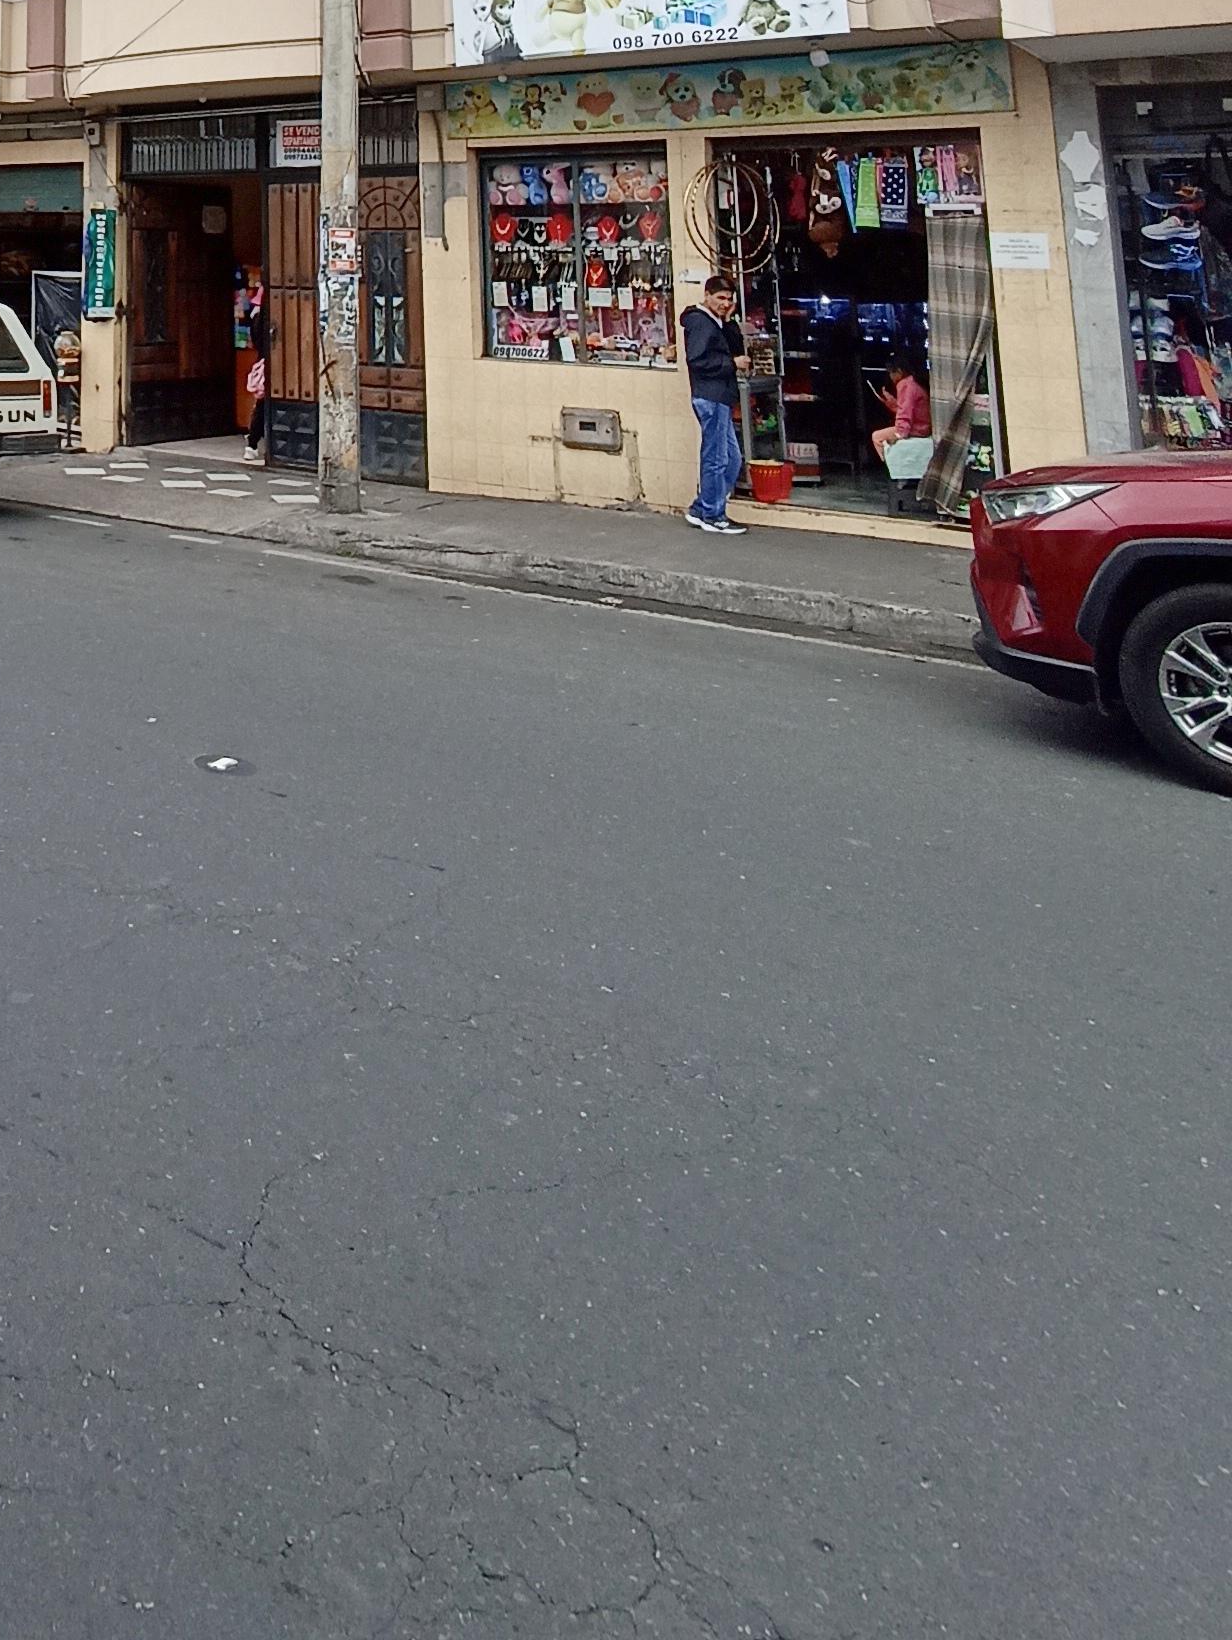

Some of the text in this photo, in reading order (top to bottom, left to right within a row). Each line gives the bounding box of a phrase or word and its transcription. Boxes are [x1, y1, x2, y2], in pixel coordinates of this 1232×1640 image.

[612, 27, 739, 50] 098 700 6222
[296, 125, 320, 136] VEND
